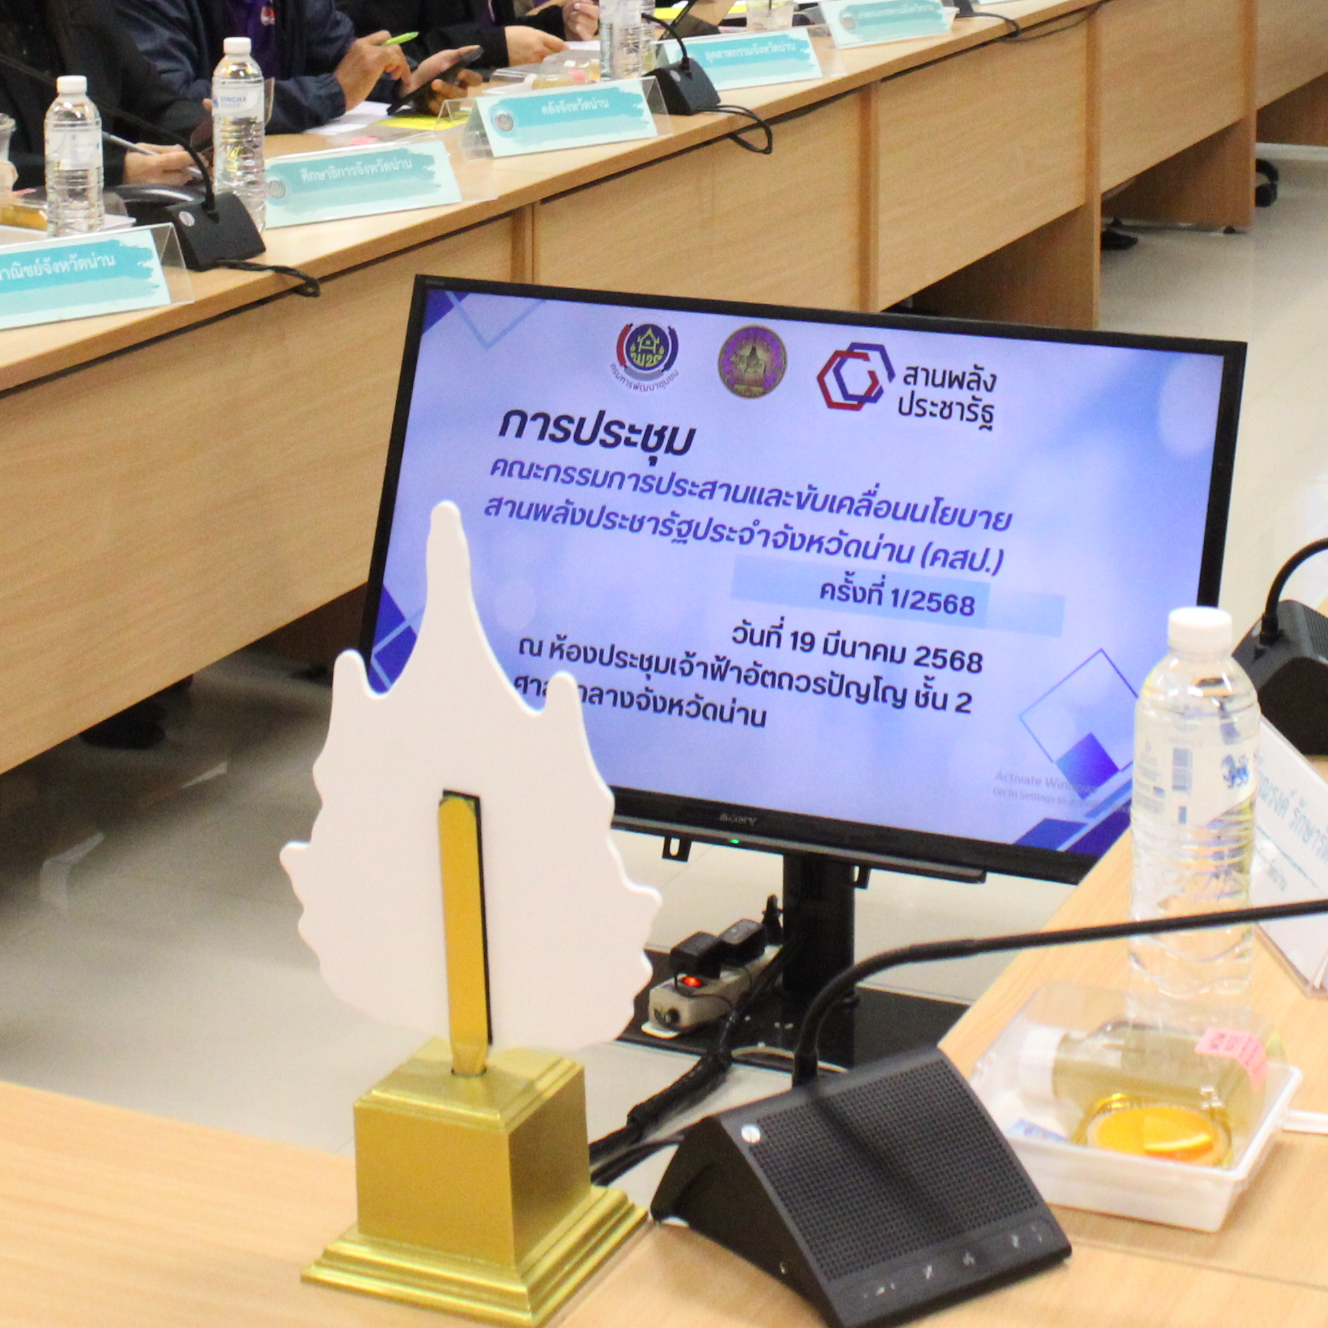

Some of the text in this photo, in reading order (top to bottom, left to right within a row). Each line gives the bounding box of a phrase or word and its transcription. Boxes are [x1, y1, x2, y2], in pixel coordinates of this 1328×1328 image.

[902, 363, 998, 393] สานพลัง
[498, 408, 697, 467] การประชุม
[898, 390, 995, 432] ประชารัฐ
[490, 458, 1013, 532] คณะกรรมการประสานและขับเคลื่อนนโยบาย
[484, 497, 1004, 576] สานพลังประชารัฐประจำจังหวัดน่าน (คสป.)
[820, 571, 976, 617] ครั้งที่ 1/2568
[518, 634, 973, 714] ณ ห้องประชุมเจ้าฟ้าอัตถวรปัญโญ ชั้น 2
[732, 615, 984, 674] วันที่ 19 มีนาคม 2568
[513, 675, 767, 728] ศากลางจังหวัดน่าน
